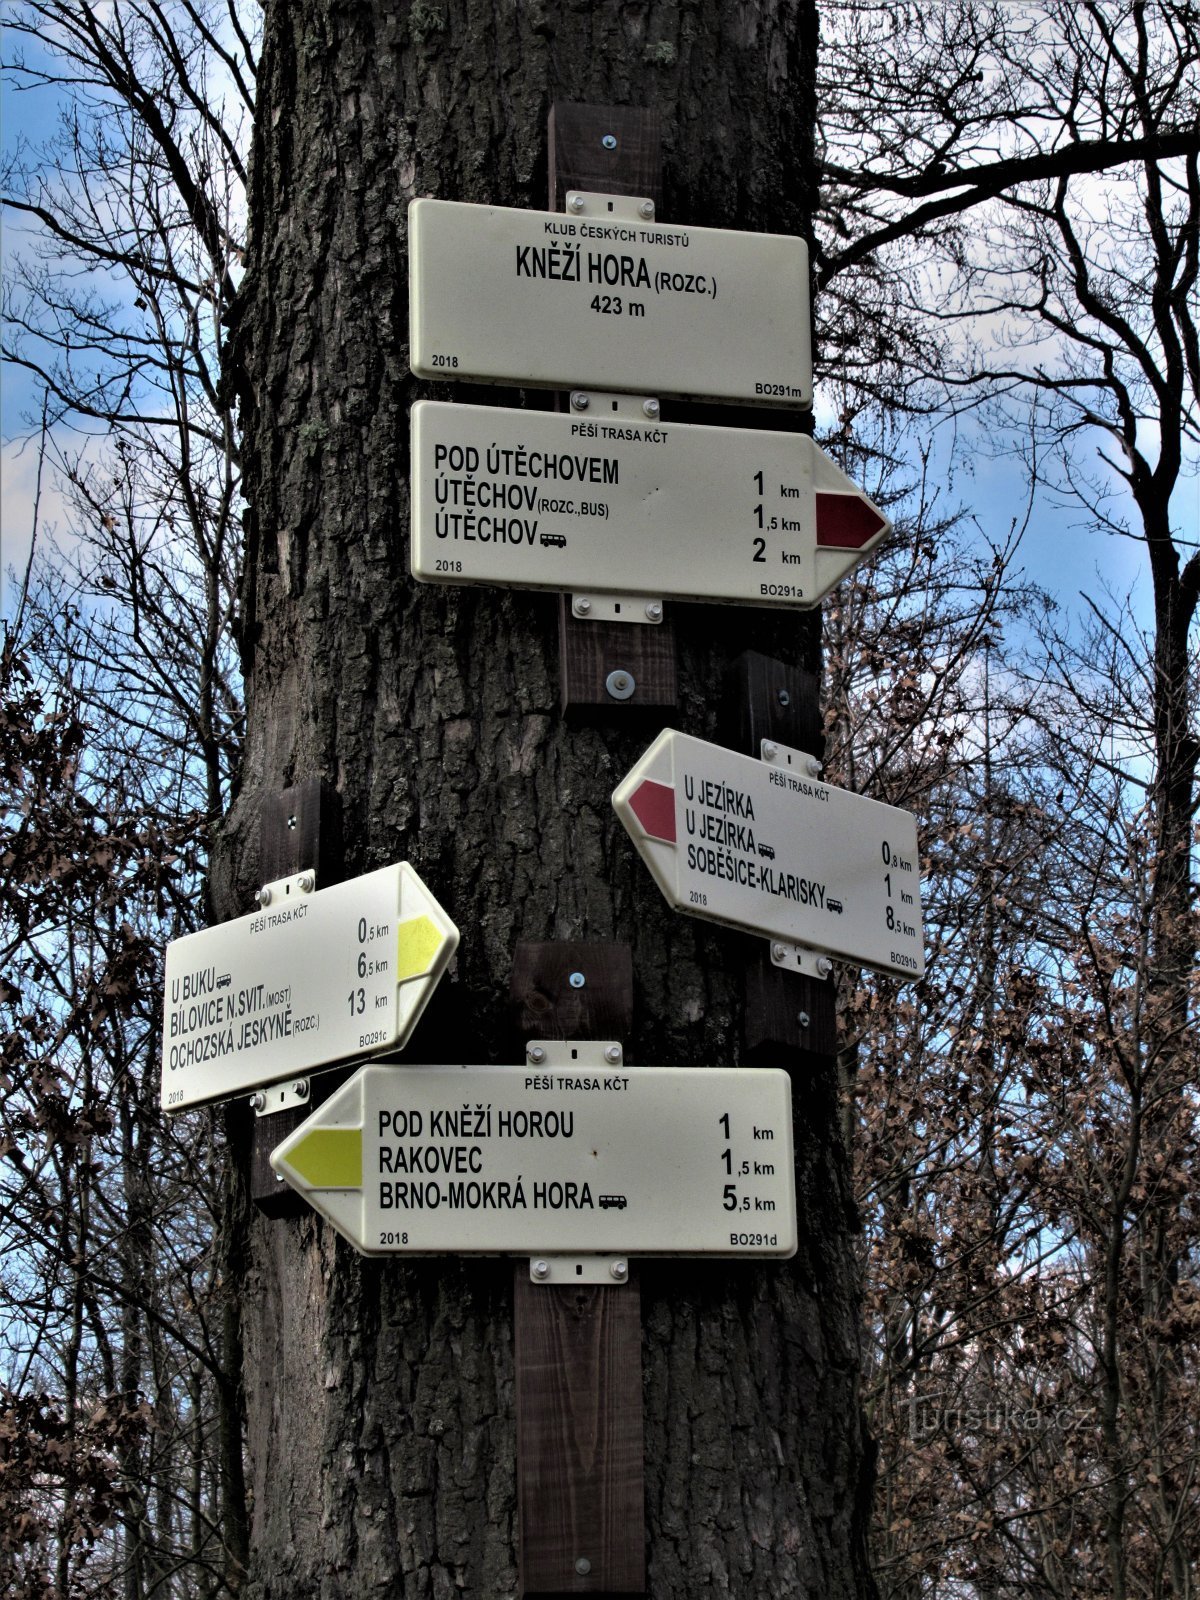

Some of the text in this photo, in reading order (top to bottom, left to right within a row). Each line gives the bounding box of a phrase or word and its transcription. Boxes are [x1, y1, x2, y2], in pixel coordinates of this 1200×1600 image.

[545, 223, 688, 247] KLUB ČESKÝCH TURISTŮ
[517, 241, 716, 299] KNĚŽÍ HORA (ROZC.)
[591, 295, 644, 316] 423 m
[432, 355, 458, 368] 2018
[756, 383, 801, 397] BO291m
[572, 423, 668, 443] PĚŠÍ TRASA KČT
[435, 443, 618, 484] POD ÚTĚCHOVEM
[754, 471, 763, 495] 1
[781, 485, 799, 498] km
[436, 513, 538, 545] ÚTĚCHOV
[782, 518, 800, 531] km
[753, 538, 766, 562] 2
[782, 551, 800, 564] km
[436, 560, 462, 572] 2018
[761, 584, 802, 597] BO291a
[770, 772, 829, 802] PĚŠÍ TRASA KČT
[685, 775, 754, 821] U JEZÍRKA
[686, 809, 756, 855] U JEZÍRKA
[900, 857, 911, 872] km
[687, 845, 825, 909] SOBĚŠICE-KLARISKY
[690, 891, 707, 906] 2018
[885, 874, 913, 904] 1 km
[250, 904, 308, 934] PĚŠÍ TRASA KČT
[377, 925, 388, 938] km
[903, 922, 915, 937] km
[376, 960, 387, 973] km
[890, 952, 917, 970] BO291b
[172, 967, 214, 1003] U BUKU
[348, 988, 387, 1016] 13 km
[171, 997, 224, 1038] BÍLOVICE
[170, 1020, 234, 1070] OCHOZSKÁ
[360, 1032, 387, 1048] BO291c
[525, 1076, 629, 1090] PĚŠÍ TRASA KČT
[169, 1090, 183, 1104] 2018
[379, 1104, 573, 1138] POD KNĚŽÍ HOROU
[719, 1113, 773, 1139] 1 km
[380, 1146, 482, 1173] RAKOVEC
[754, 1161, 774, 1174] km
[380, 1175, 594, 1209] BRNO-MOKRÁ HORA
[755, 1197, 775, 1210] km
[380, 1232, 408, 1244] 2018
[730, 1234, 777, 1245] BO291d
